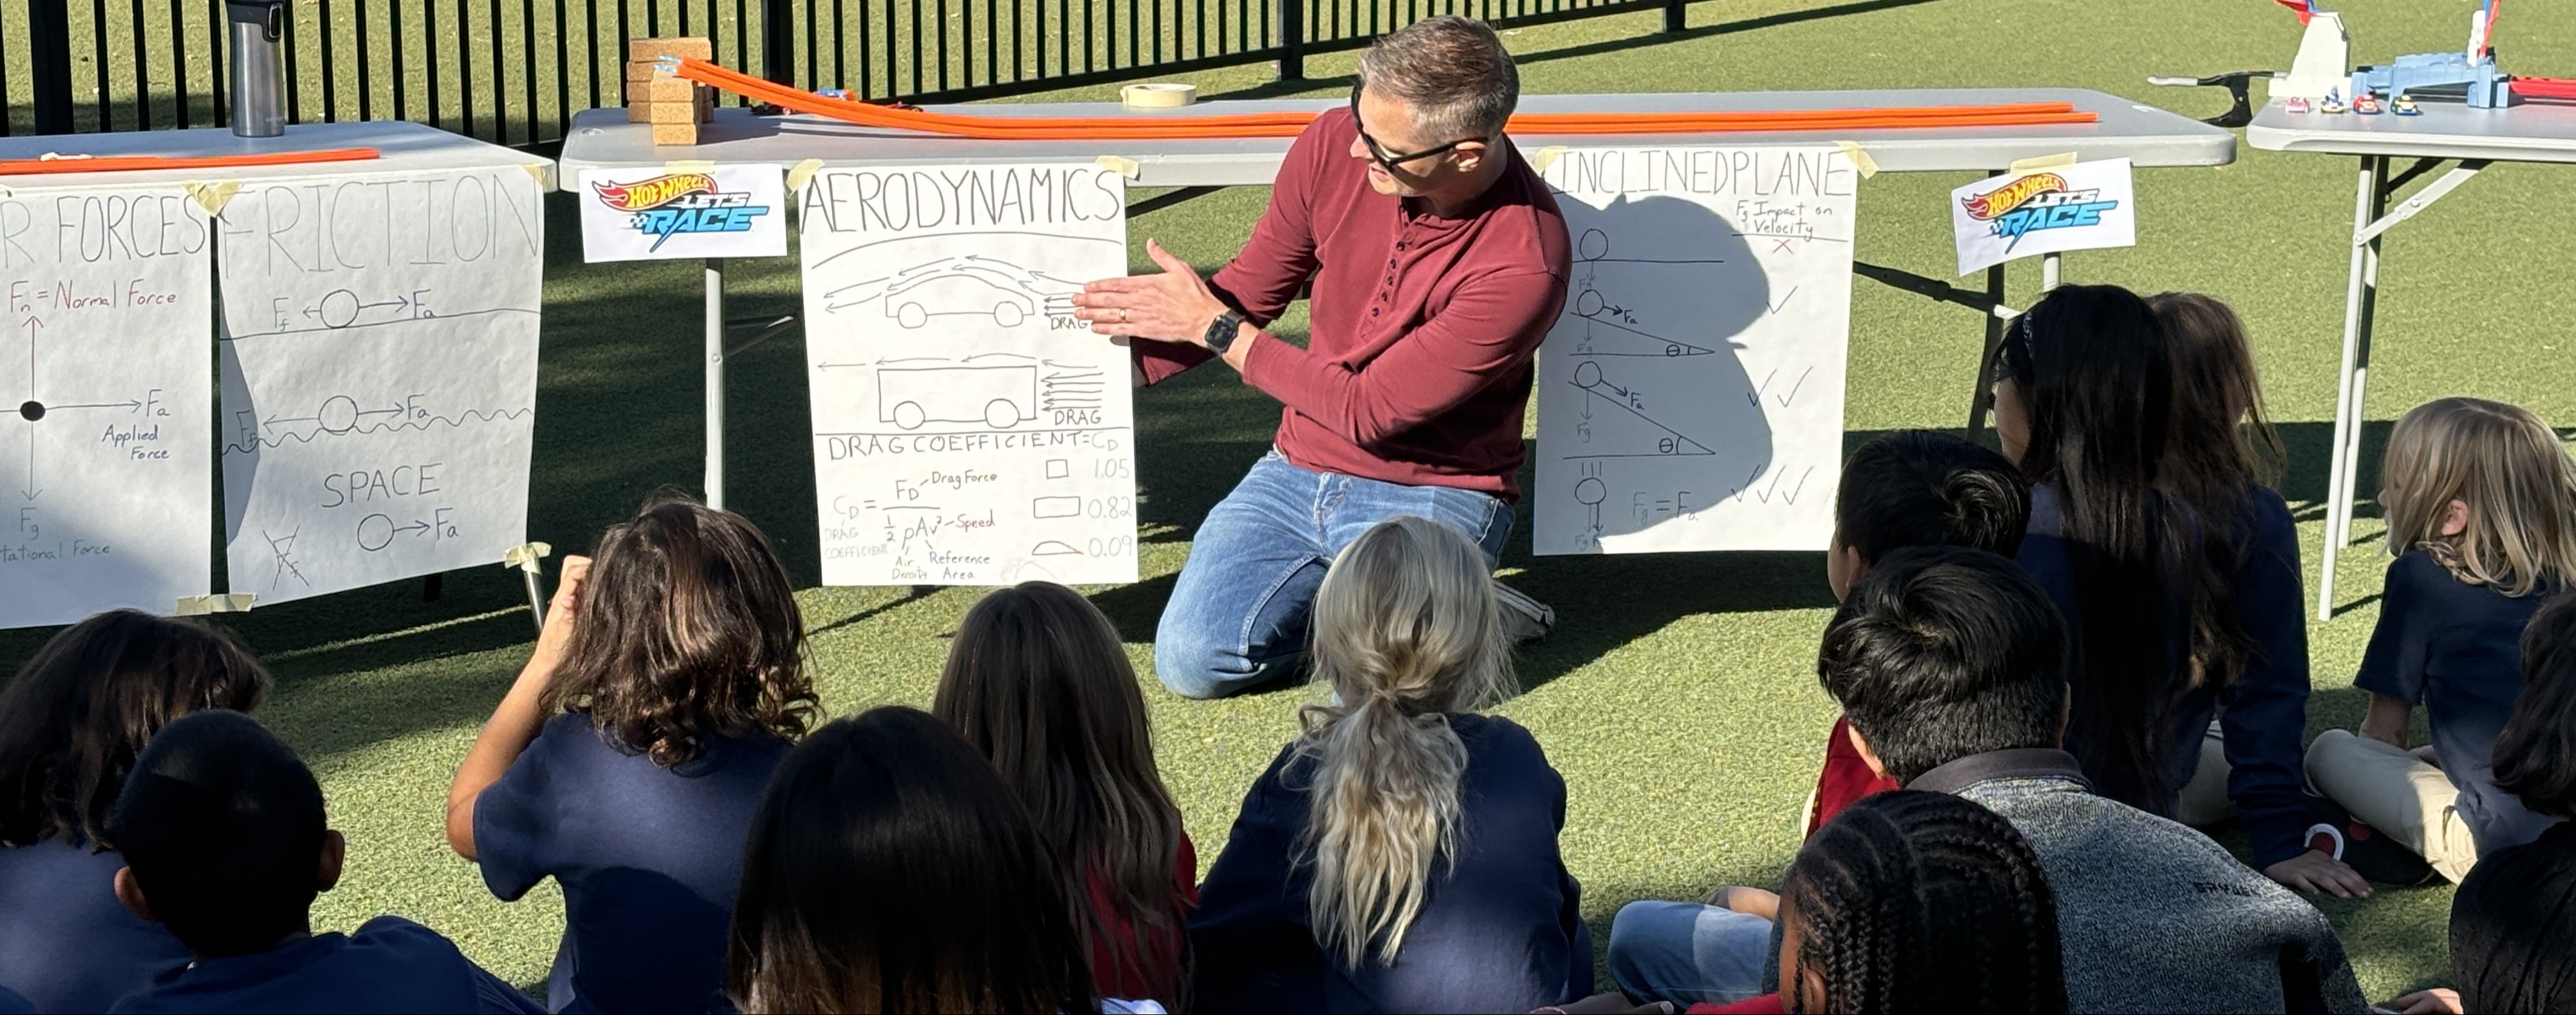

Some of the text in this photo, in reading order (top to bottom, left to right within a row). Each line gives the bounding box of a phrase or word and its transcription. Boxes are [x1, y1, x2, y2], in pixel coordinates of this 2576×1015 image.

[677, 193, 749, 209] LET'S
[801, 168, 1119, 235] AERODYNAMICS
[2030, 190, 2099, 206] LET'S
[1753, 201, 1805, 224] Impact
[1815, 206, 1833, 215] on
[57, 194, 206, 263] FORCES
[221, 172, 539, 279] FRICTION
[643, 206, 769, 249] RACE
[1754, 217, 1813, 242] Velocity
[2000, 201, 2118, 250] RACE
[54, 279, 116, 310] Normal
[128, 278, 176, 308] Force
[413, 289, 436, 319] Fa
[1050, 316, 1089, 331] DRAG
[146, 388, 171, 418] Fa
[407, 393, 430, 420] Fa
[1055, 408, 1102, 426] DRAG
[101, 424, 158, 448] Applied
[130, 446, 170, 460] Force
[830, 436, 905, 461] DRAG
[931, 469, 998, 490] Drag Force
[1094, 458, 1130, 479] 1.05
[321, 462, 443, 508] SPACE
[1088, 496, 1133, 519] 0.82
[20, 507, 39, 540] Fg
[434, 507, 459, 541] Fa
[956, 509, 995, 533] Speed
[825, 527, 859, 542] DRAG
[73, 539, 111, 556] Force
[824, 543, 889, 560] COEFFICIENT
[929, 550, 991, 565] Reference
[1088, 535, 1132, 558] 0.09
[892, 565, 928, 581] Density
[895, 556, 914, 567] Air
[942, 566, 976, 580] Area
